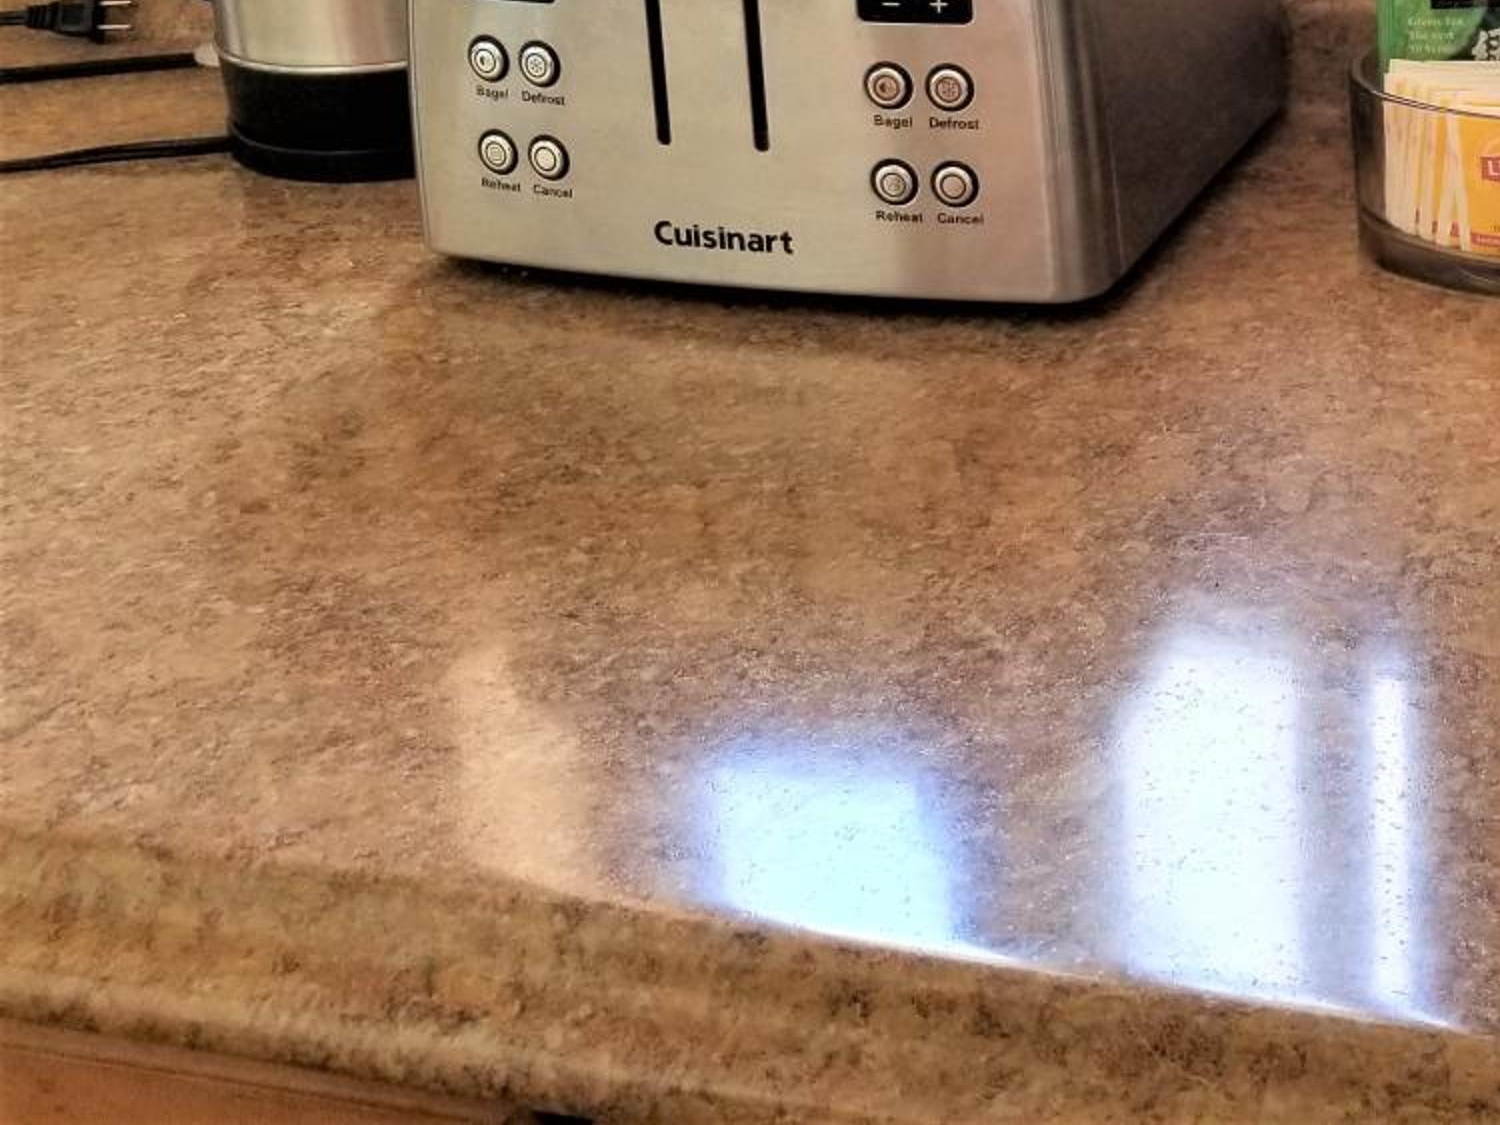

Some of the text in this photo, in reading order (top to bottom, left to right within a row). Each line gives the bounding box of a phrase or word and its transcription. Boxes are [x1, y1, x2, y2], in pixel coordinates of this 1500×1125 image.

[476, 84, 509, 101] Bagel
[521, 90, 566, 106] Defrost
[873, 115, 913, 130] Bagel
[929, 116, 980, 130] Defrost
[481, 177, 521, 192] Reheat
[533, 184, 573, 198] Cancel
[875, 210, 923, 223] Reheat
[937, 212, 985, 225] Cancel
[654, 220, 793, 254] Cuisinart
